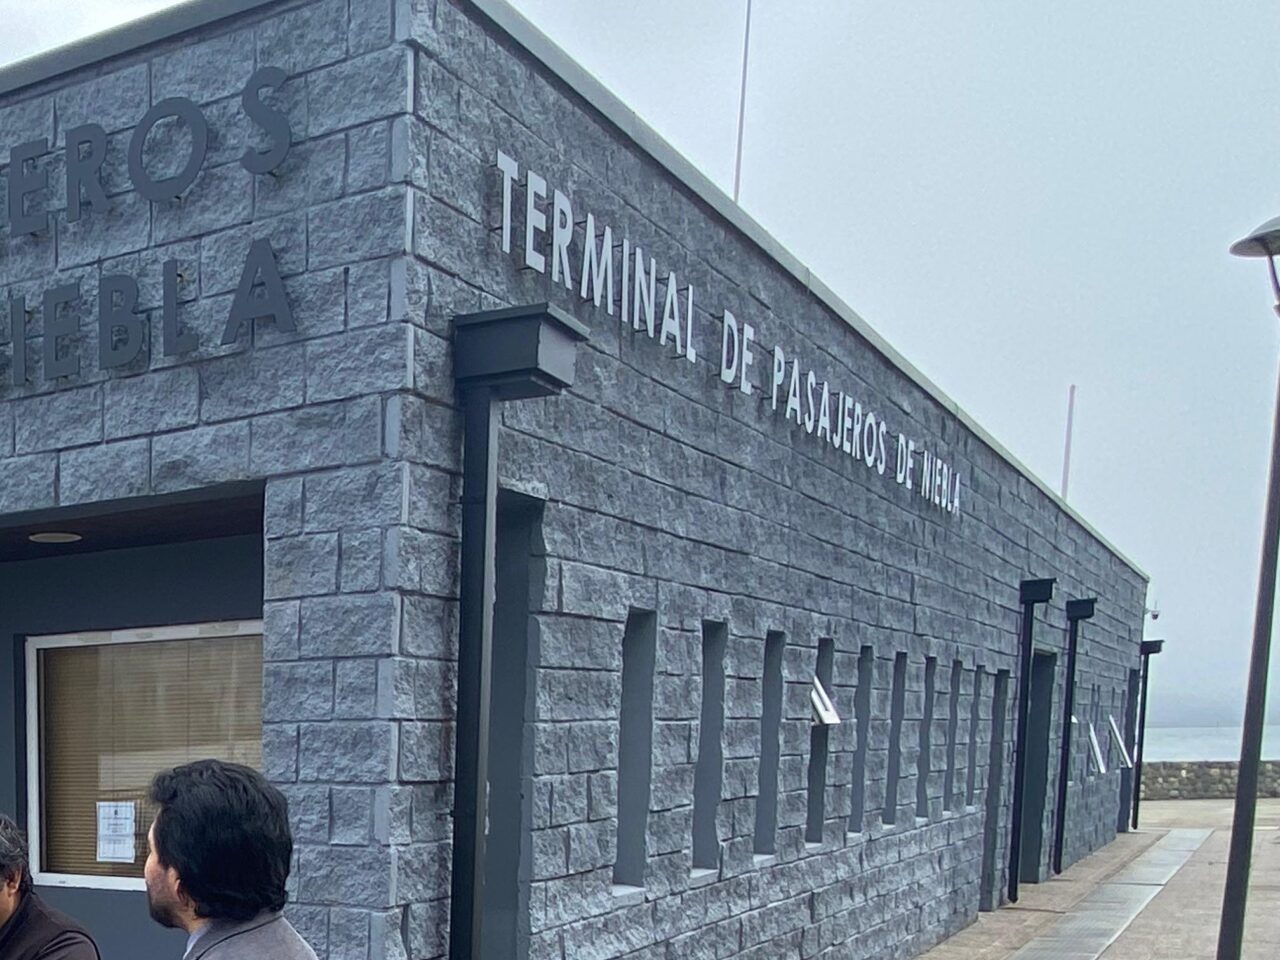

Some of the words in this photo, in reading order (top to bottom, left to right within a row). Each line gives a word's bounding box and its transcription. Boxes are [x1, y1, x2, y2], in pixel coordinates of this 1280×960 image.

[496, 149, 696, 364] TERMINAL
[721, 309, 755, 395] DE
[771, 345, 888, 475] PASAJEROS
[896, 432, 915, 490] DE
[921, 449, 960, 517] NIEBLA
